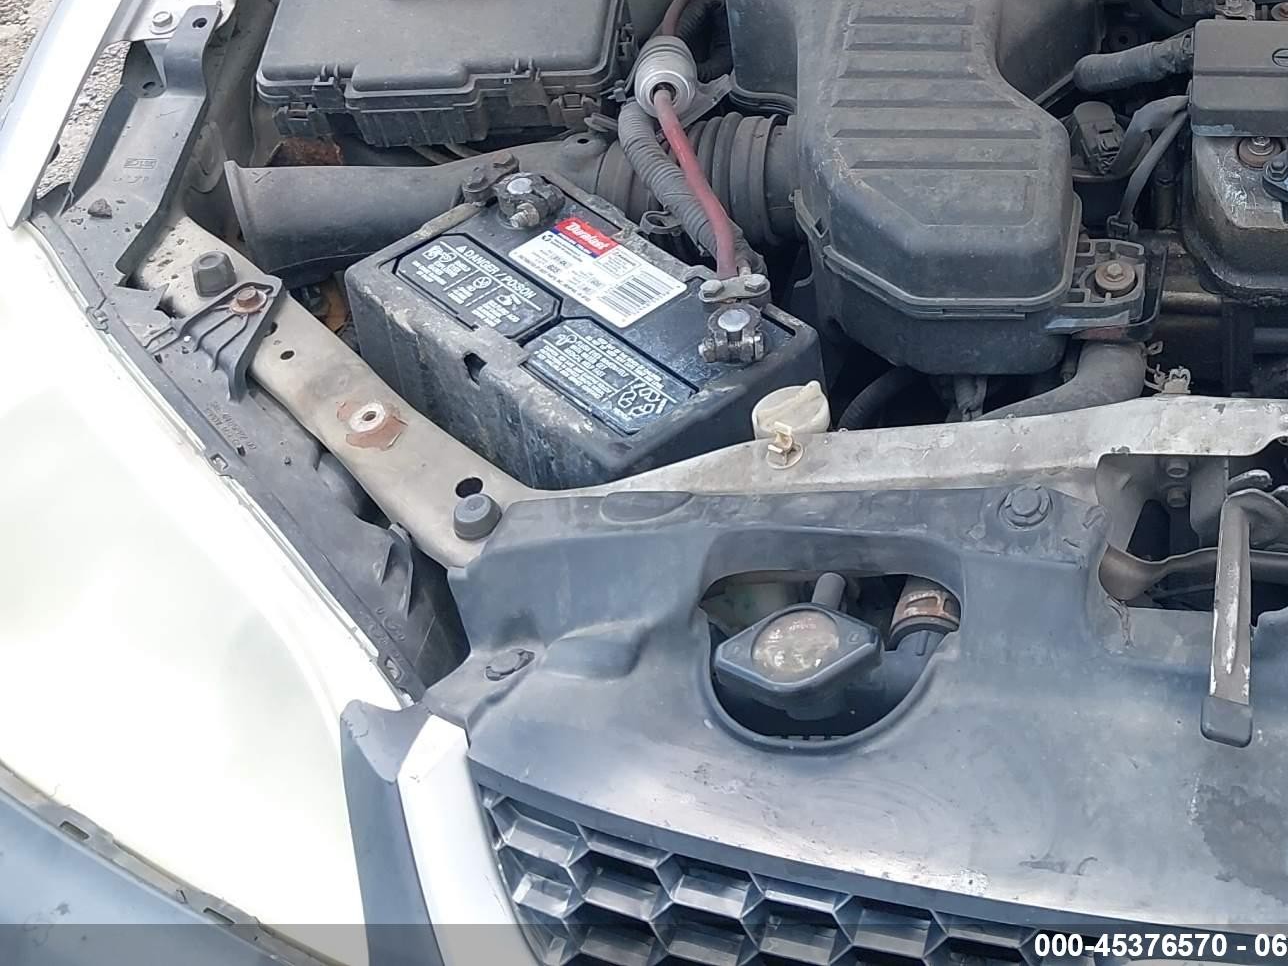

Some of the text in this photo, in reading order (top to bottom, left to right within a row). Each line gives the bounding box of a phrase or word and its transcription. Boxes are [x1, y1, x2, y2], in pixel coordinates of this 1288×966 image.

[565, 221, 610, 251] Duralast
[463, 248, 501, 275] DANGER
[500, 274, 537, 299] POISON
